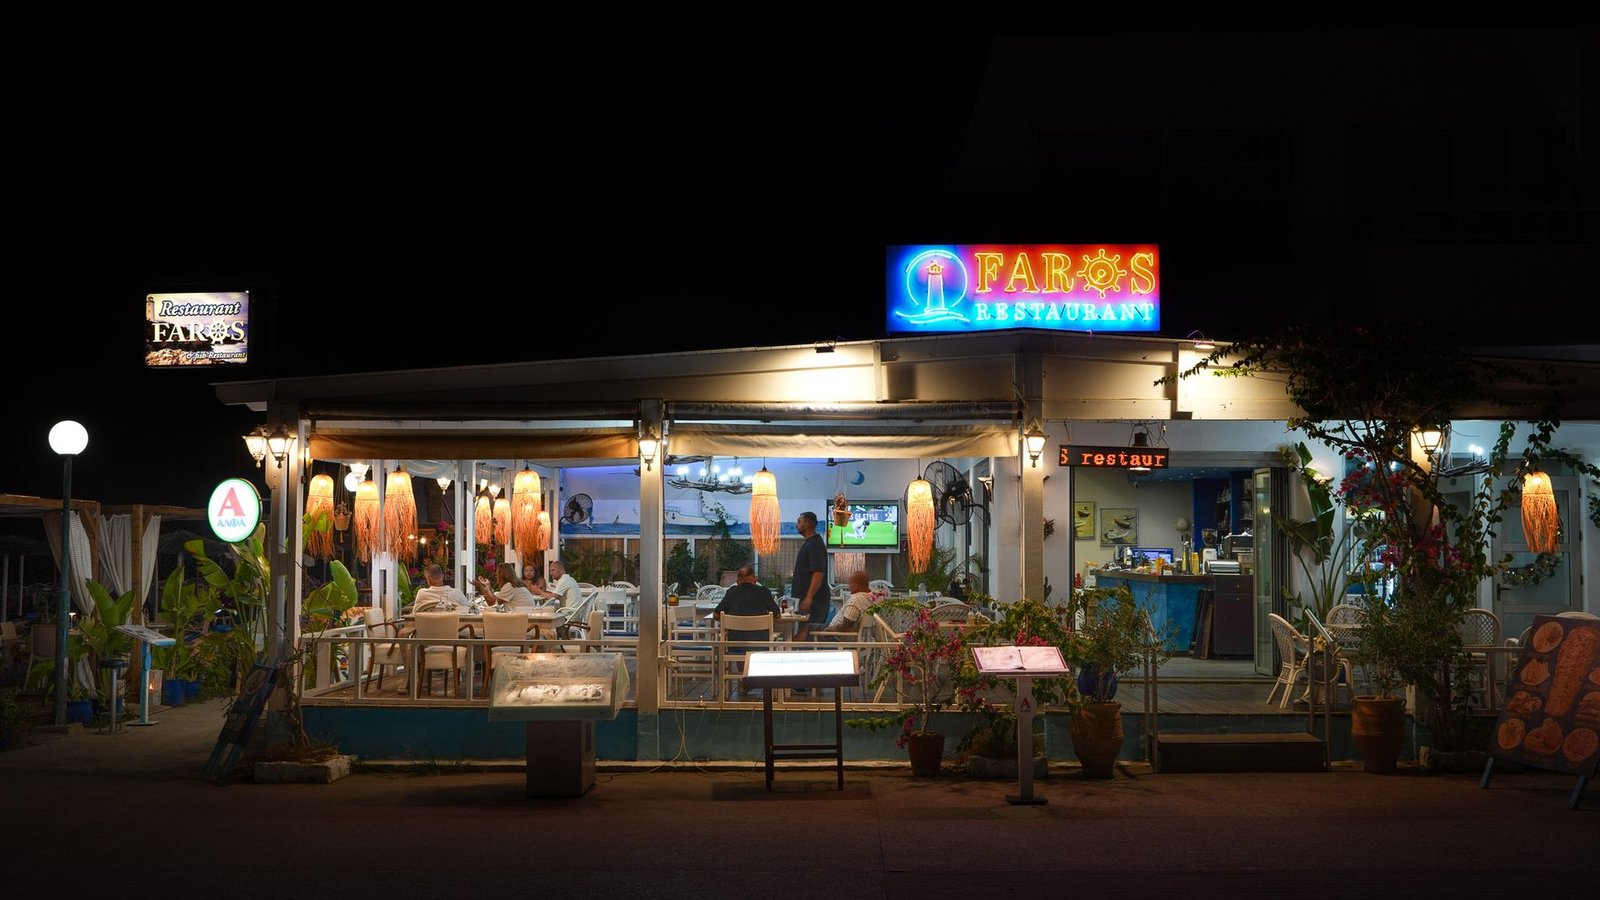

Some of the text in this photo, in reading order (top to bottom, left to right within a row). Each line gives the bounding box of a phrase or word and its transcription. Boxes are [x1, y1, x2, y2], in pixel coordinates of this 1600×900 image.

[974, 249, 1156, 298] FAROS
[159, 300, 241, 316] Restaurant
[975, 303, 1154, 322] RESTAURANT
[151, 319, 245, 344] FAROS
[209, 351, 246, 359] Restaurant
[1081, 451, 1166, 467] restaur
